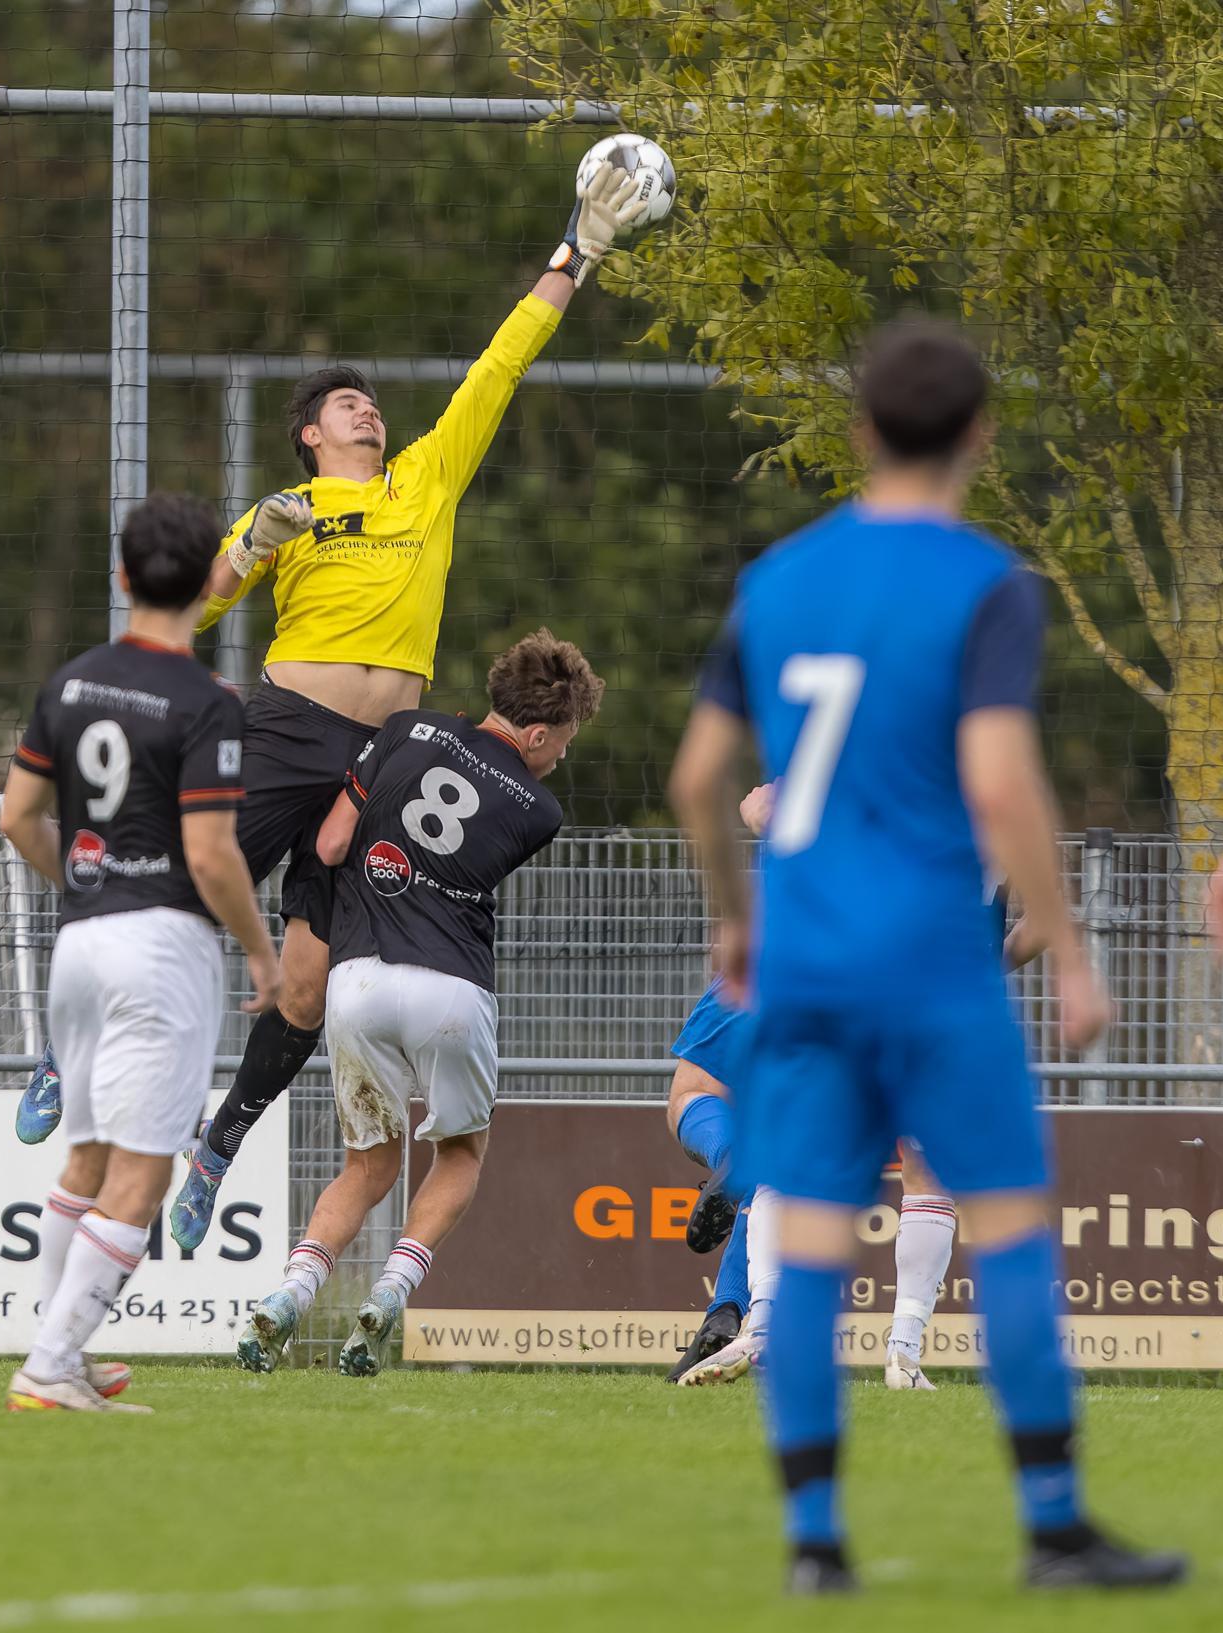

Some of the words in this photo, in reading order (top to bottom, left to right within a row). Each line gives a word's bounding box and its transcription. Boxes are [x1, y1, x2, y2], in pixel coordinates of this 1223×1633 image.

[371, 541, 378, 550] &
[76, 719, 132, 823] 9
[431, 736, 487, 778] ORIENTAL
[499, 783, 531, 811] FOOD
[436, 729, 480, 765] HEUSCHEN
[479, 762, 488, 770] &
[489, 767, 536, 803] SCHROUFF
[777, 652, 867, 857] 7
[401, 766, 480, 856] 8
[369, 855, 407, 874] SPORT
[180, 1299, 215, 1323] 25
[1049, 1272, 1223, 1311] rojectst
[424, 1321, 697, 1354] www.gbstofferin
